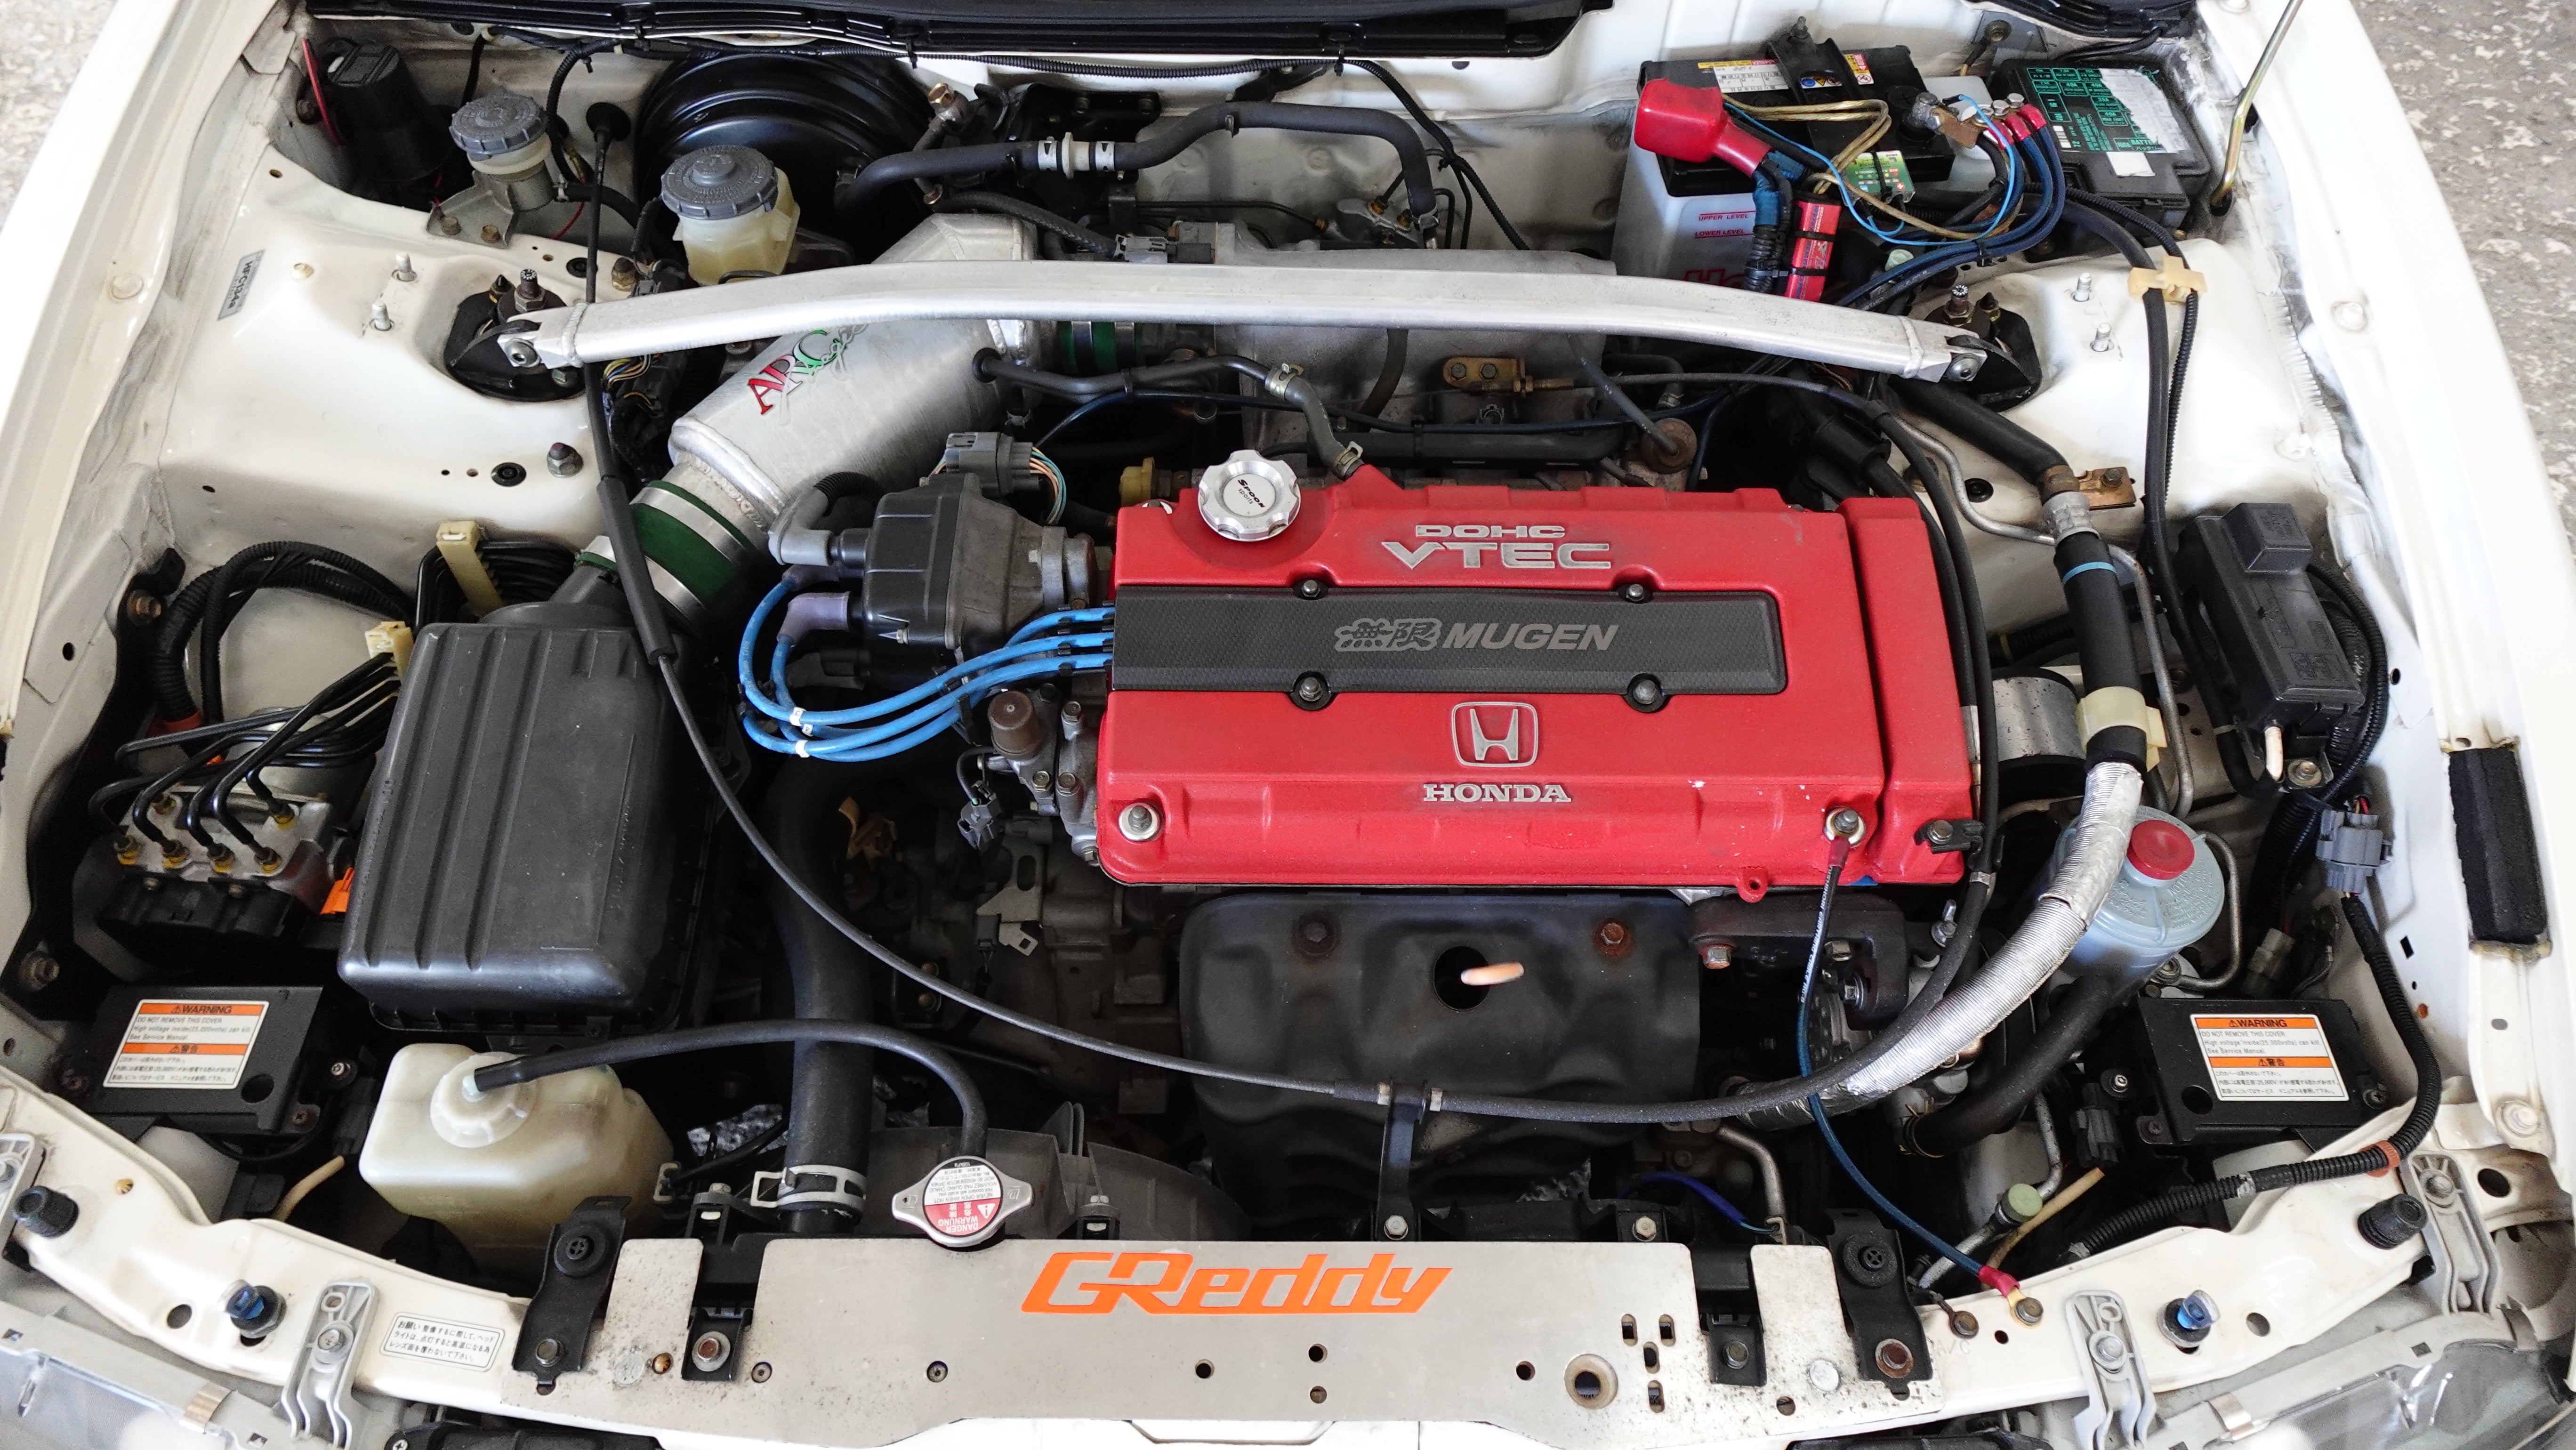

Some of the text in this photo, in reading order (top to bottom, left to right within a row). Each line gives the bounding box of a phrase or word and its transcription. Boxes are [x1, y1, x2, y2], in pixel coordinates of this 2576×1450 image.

[748, 329, 843, 415] ARC
[1238, 488, 1254, 504] sports
[1415, 525, 1565, 539] DOHC
[1382, 542, 1612, 569] VTEC
[1335, 618, 1619, 652] 無限 MUGEN
[1423, 783, 1572, 803] HONDA
[182, 1006, 233, 1014] WARNING
[2267, 1058, 2285, 1066] 警告
[938, 1216, 978, 1226] WARNUNG
[945, 1223, 979, 1232] DANGER
[1022, 1252, 1453, 1315] GReddy
[397, 1321, 420, 1329] お願い
